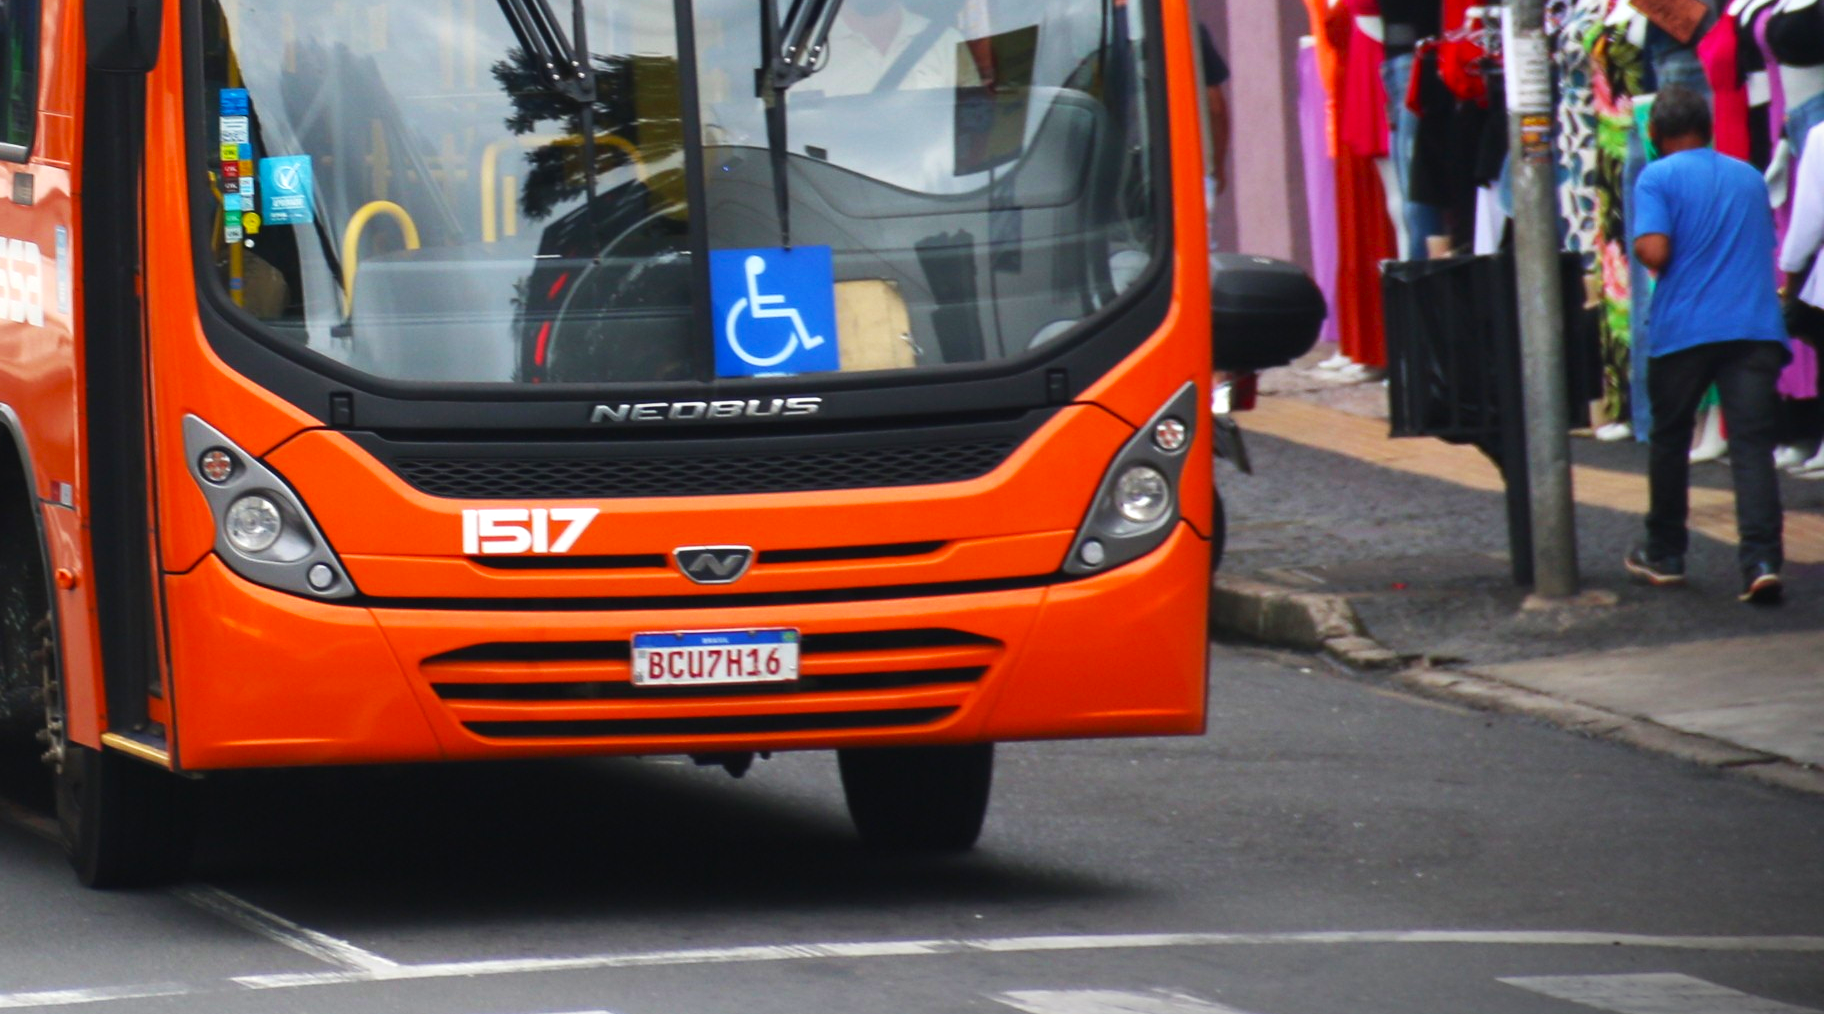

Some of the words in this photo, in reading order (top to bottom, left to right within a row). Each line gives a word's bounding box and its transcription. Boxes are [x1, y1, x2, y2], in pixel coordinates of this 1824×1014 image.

[589, 395, 823, 424] NEOBUS
[462, 507, 601, 555] 1517
[648, 646, 781, 680] BCU7H16
